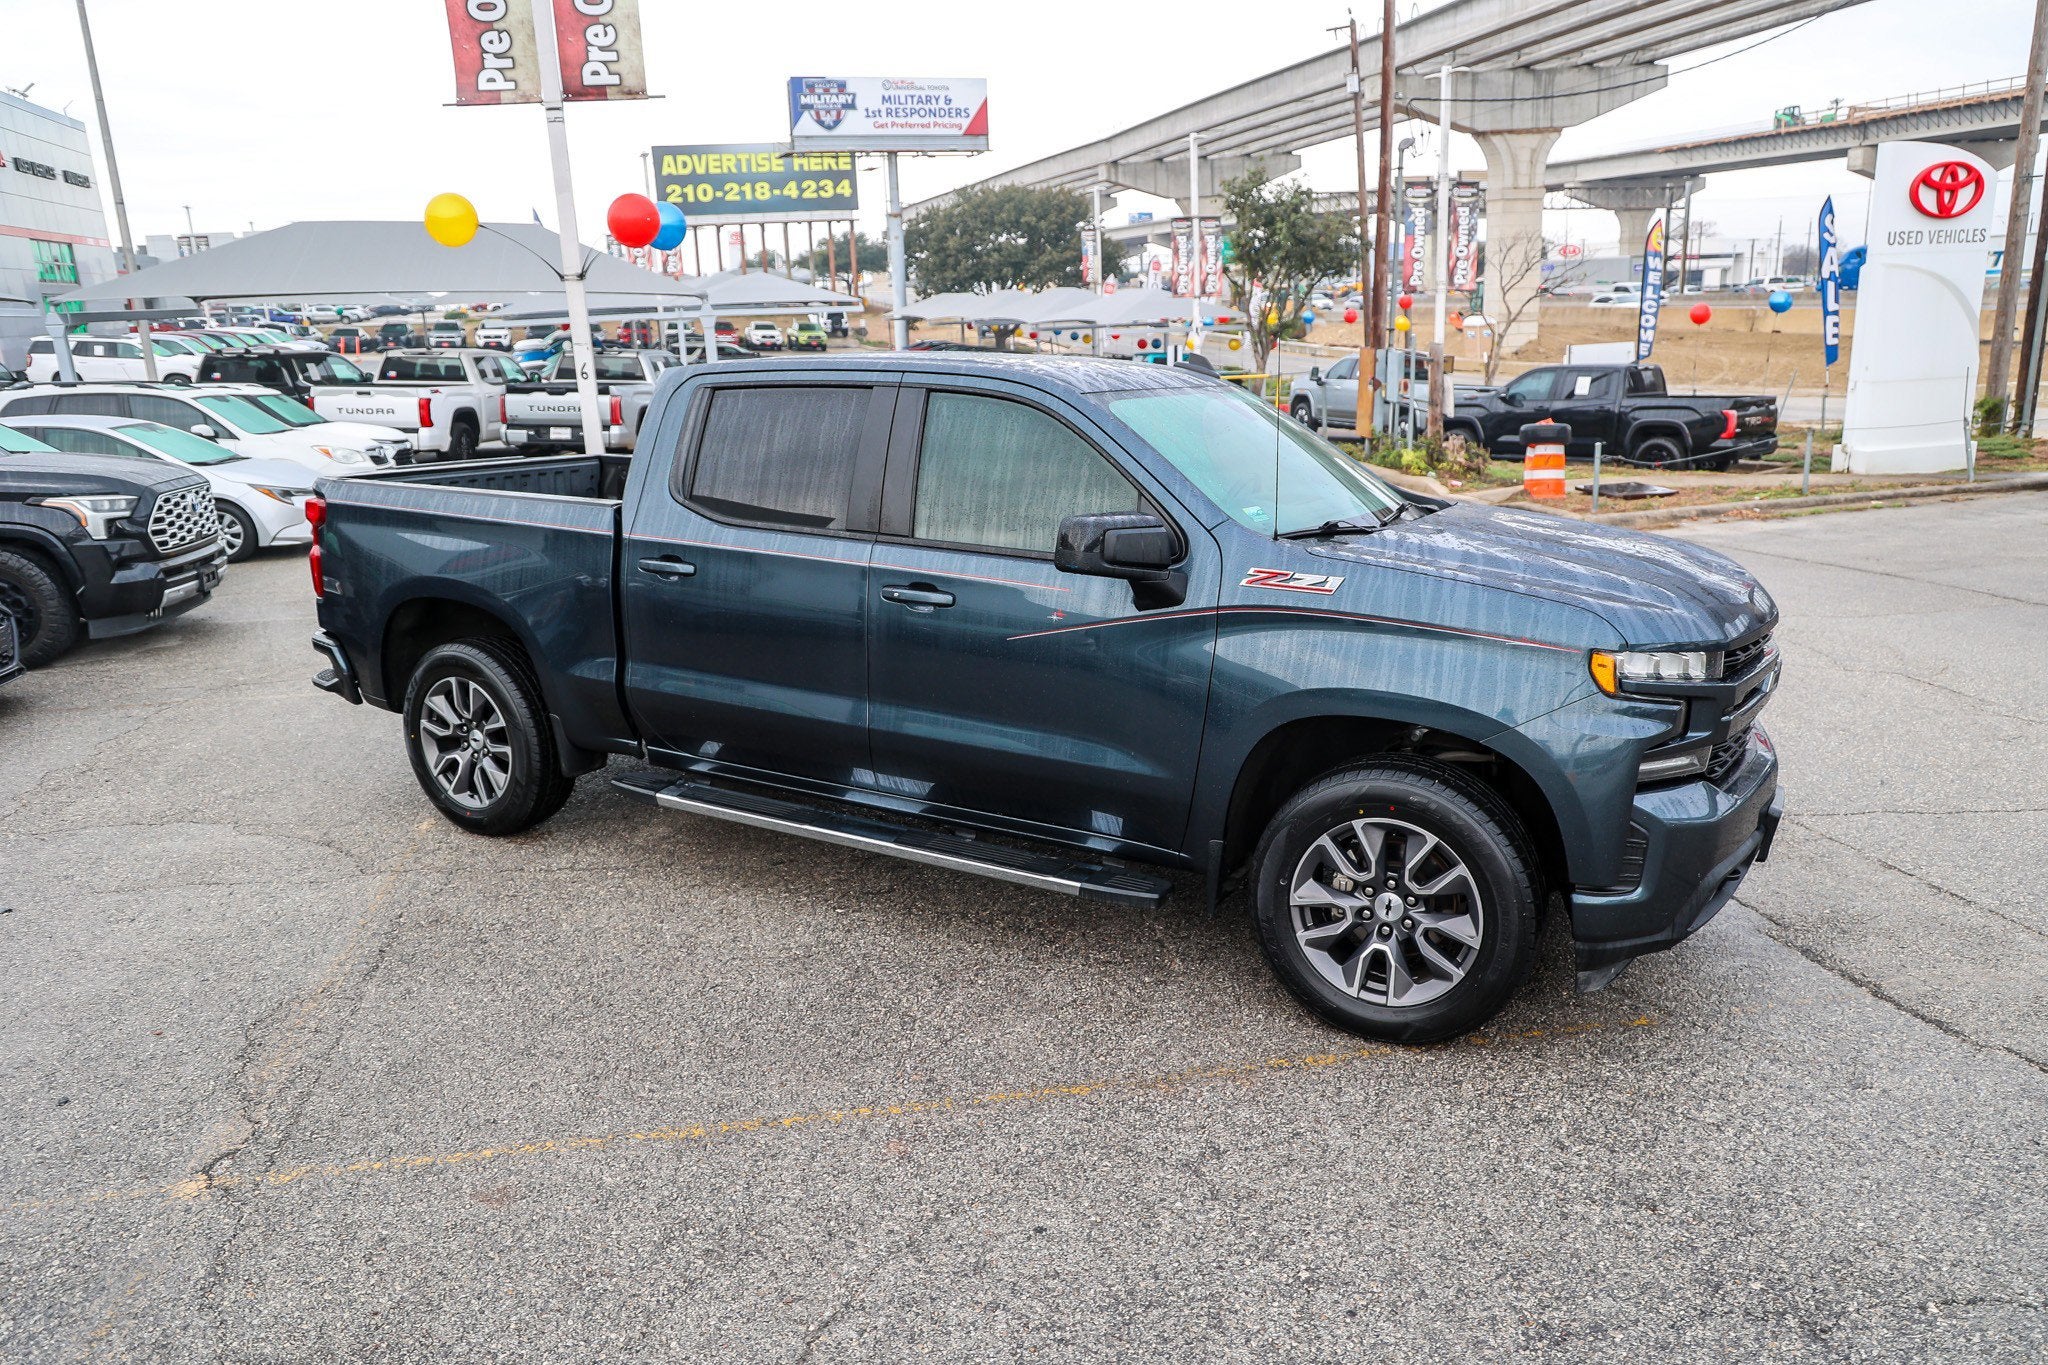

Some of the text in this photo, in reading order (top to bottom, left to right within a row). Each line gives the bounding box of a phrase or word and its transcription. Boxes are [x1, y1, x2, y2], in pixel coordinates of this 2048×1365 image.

[477, 30, 517, 91] Pre
[581, 23, 622, 86] Pre
[800, 92, 853, 104] MILITARY
[881, 94, 953, 106] MILITARY &
[864, 107, 970, 119] 1st RESPONDERS
[872, 120, 963, 131] Get Preferred Pricing
[661, 152, 852, 176] ADVERTISE HERE
[665, 178, 853, 204] 210-218-4234
[1410, 207, 1426, 260] Owned
[1455, 206, 1470, 259] Owned
[1887, 228, 1987, 246] USED VEHICLES
[1408, 260, 1424, 286] Pre
[1453, 259, 1468, 286] Pre
[1821, 213, 1840, 346] SALE
[1639, 255, 1663, 356] WELCOME
[581, 362, 589, 380] 6
[336, 407, 395, 415] TUNDRA
[1239, 567, 1346, 596] Z71
